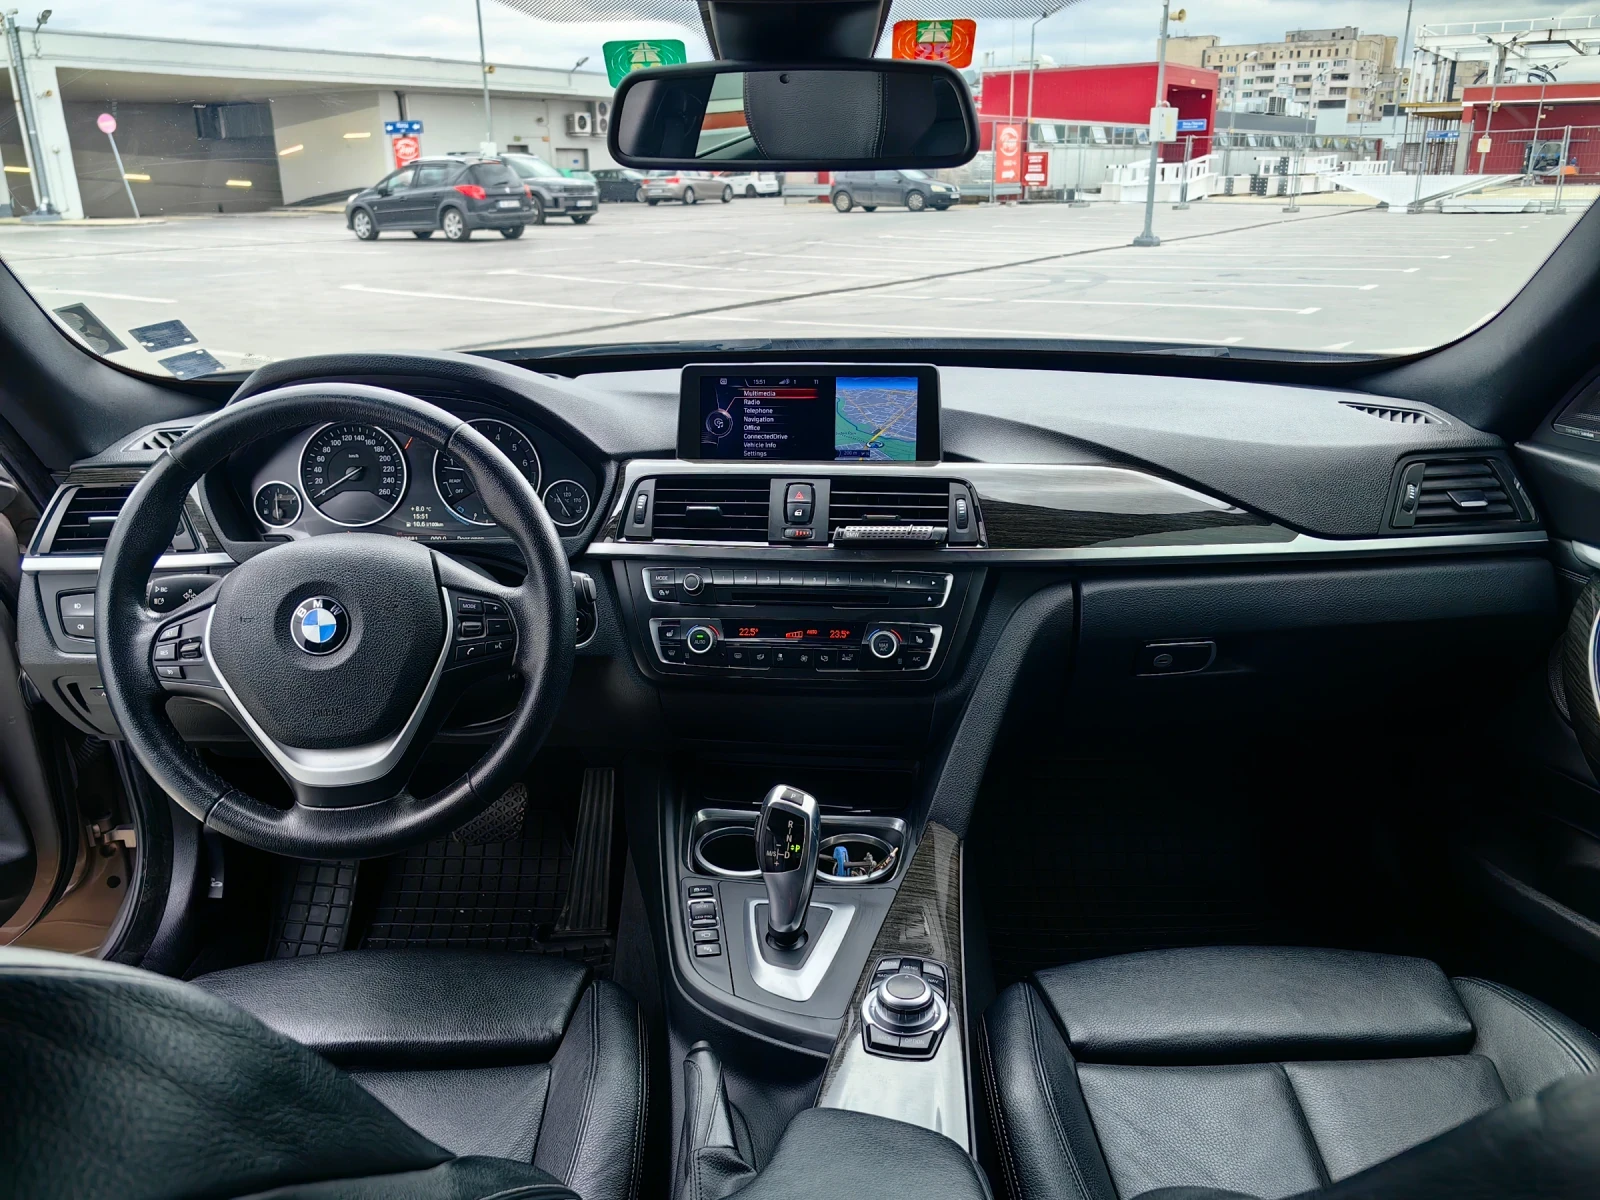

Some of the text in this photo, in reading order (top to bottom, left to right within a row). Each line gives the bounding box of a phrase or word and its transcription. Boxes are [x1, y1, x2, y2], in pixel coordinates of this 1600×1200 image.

[743, 416, 775, 424] Navigation
[297, 600, 342, 618] BMW
[739, 628, 758, 636] 22.5°
[830, 630, 850, 638] 23.5°
[788, 820, 794, 828] R
[786, 834, 792, 842] N
[795, 844, 800, 852] P
[784, 850, 791, 858] D
